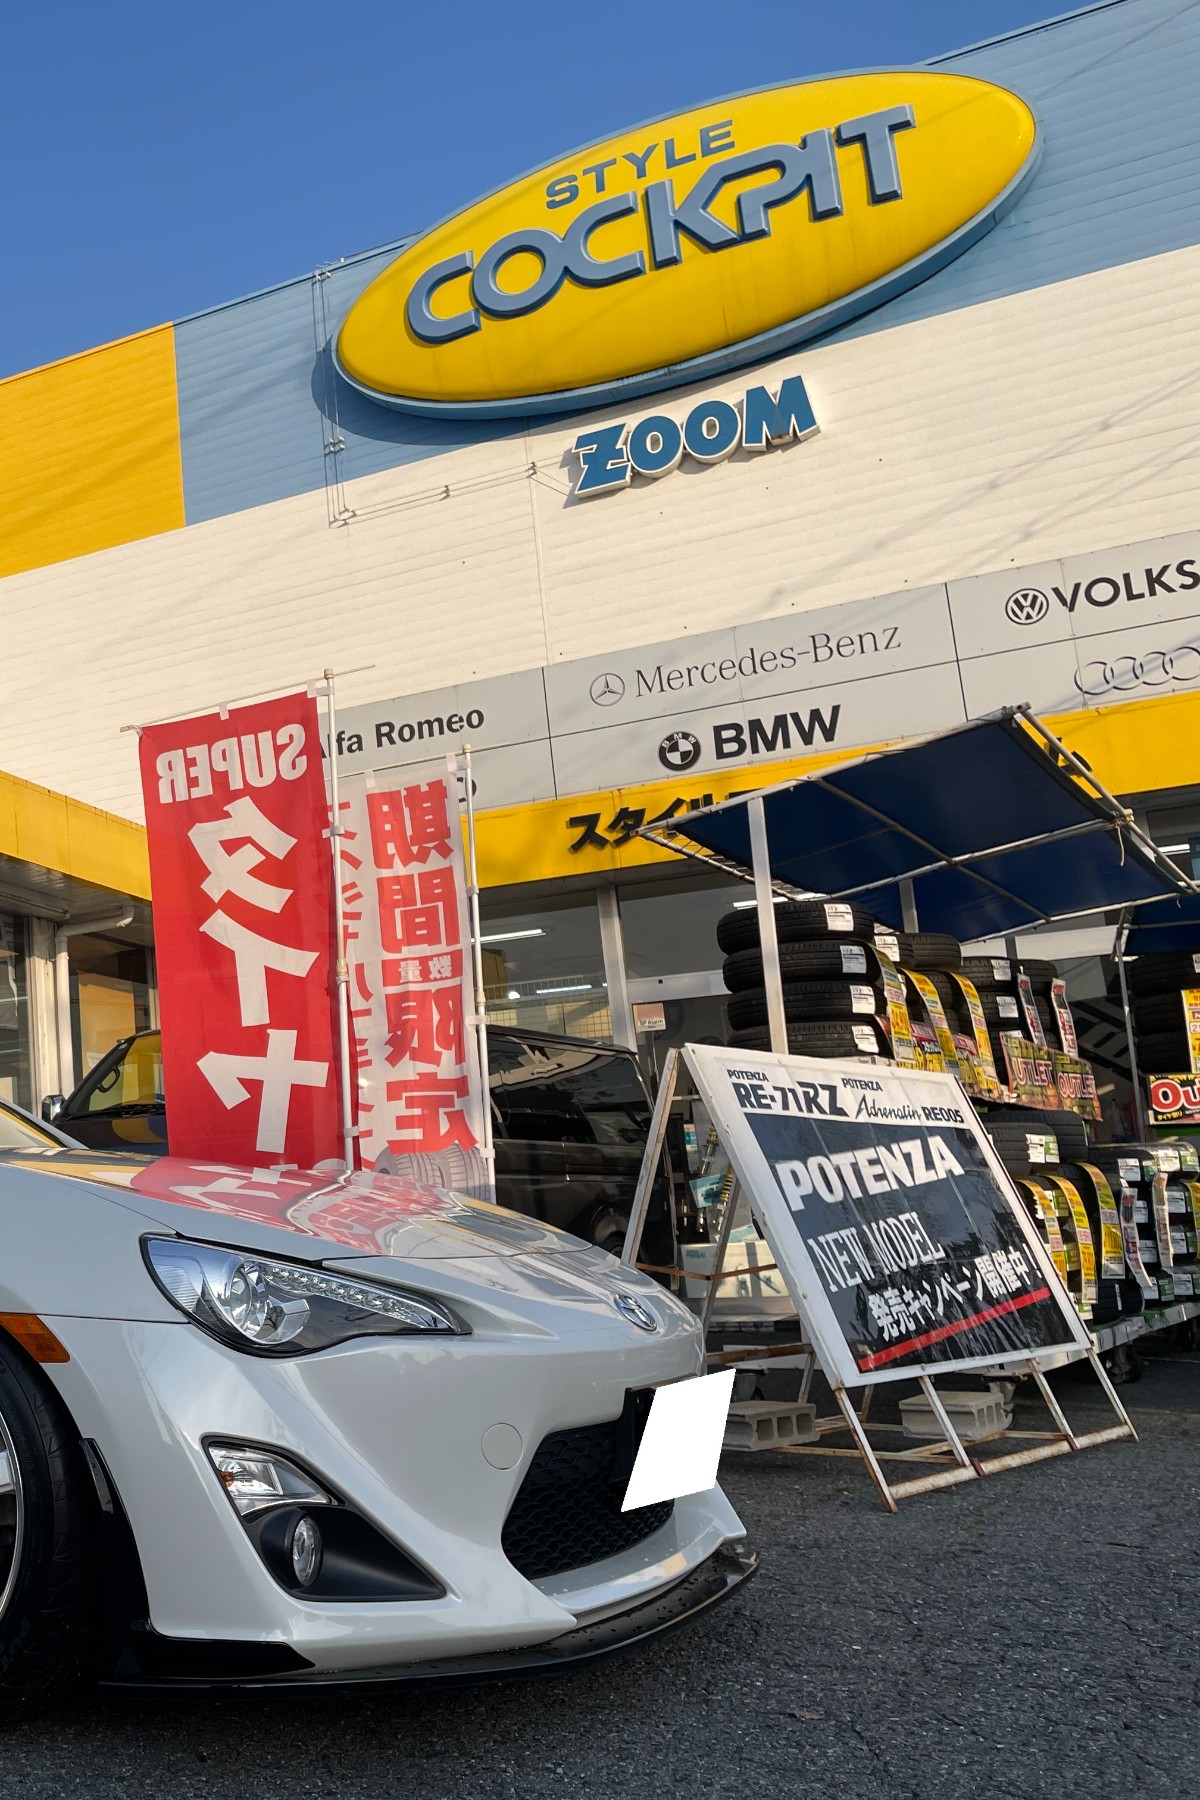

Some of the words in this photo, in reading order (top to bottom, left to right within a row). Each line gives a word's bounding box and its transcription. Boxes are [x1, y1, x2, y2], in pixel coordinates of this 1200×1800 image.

[546, 119, 736, 210] STYLE
[405, 104, 916, 345] COCKPIT
[571, 375, 821, 500] ZOOM
[1051, 559, 1200, 613] VOLKS
[634, 626, 902, 697] Mercedes-Benz
[375, 709, 485, 749] Romeo
[712, 704, 841, 760] BMW
[727, 1069, 769, 1082] POTENZA
[841, 1078, 883, 1092] POTENZA
[854, 1094, 922, 1121] Adrenalin
[921, 1106, 965, 1124] RE005
[774, 1135, 965, 1211] POTENZA
[807, 1227, 876, 1293] NEW
[862, 1211, 946, 1275] MODEL
